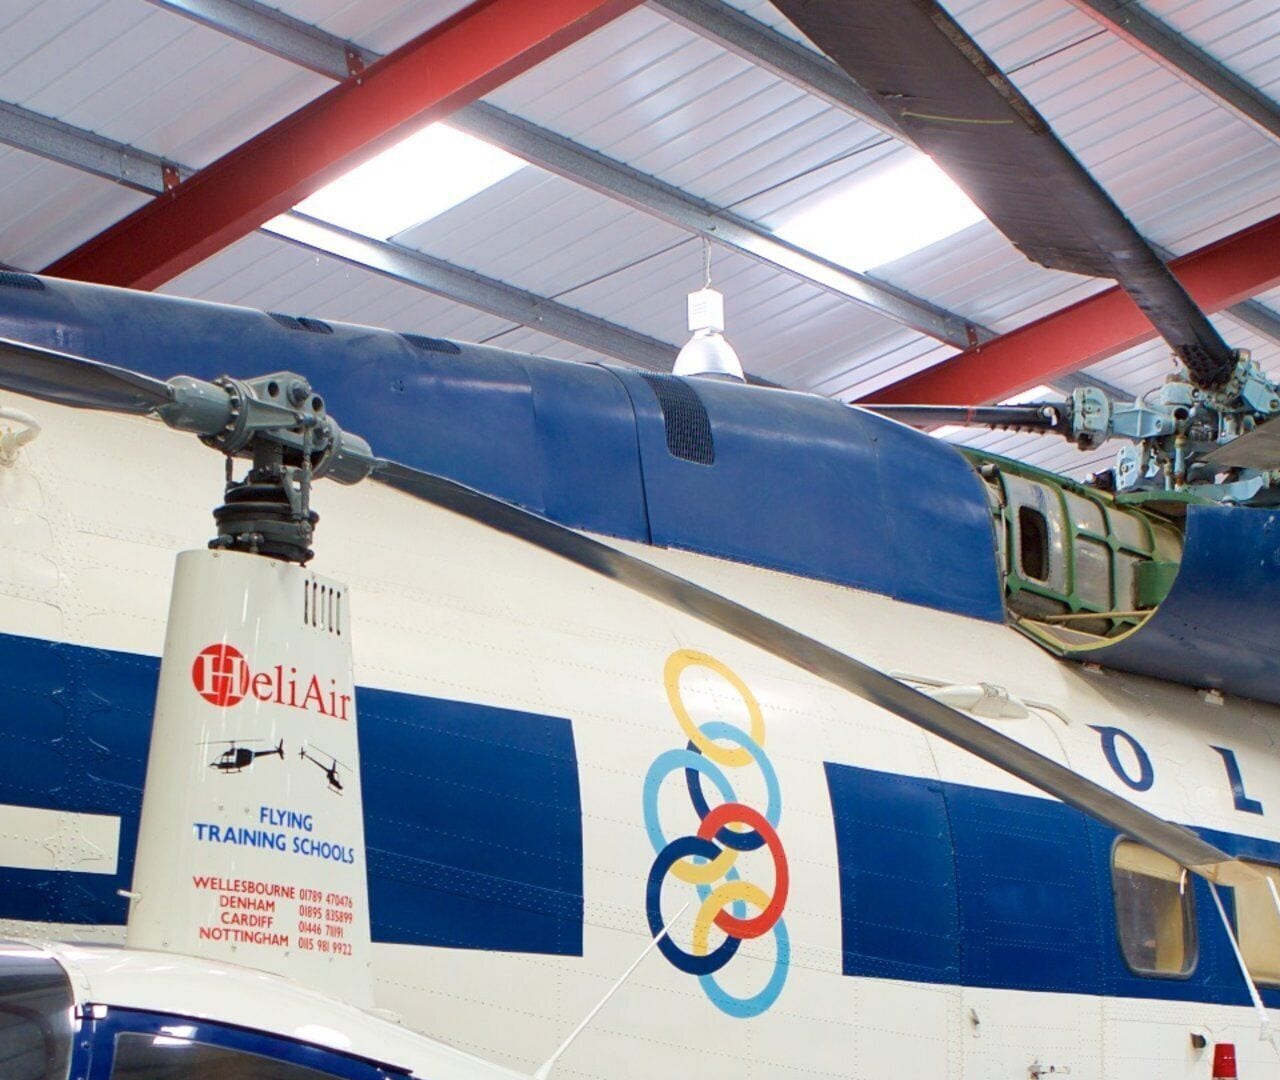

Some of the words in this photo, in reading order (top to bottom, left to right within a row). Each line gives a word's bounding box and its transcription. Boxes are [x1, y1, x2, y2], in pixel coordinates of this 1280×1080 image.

[192, 643, 351, 721] HeliAir
[260, 806, 313, 831] FLYING
[193, 823, 287, 851] TRAINING
[292, 836, 354, 864] SCHOOLS
[192, 875, 295, 899] WELLESBOURNE
[299, 888, 322, 903] 01789
[219, 895, 275, 912] DENHAM
[299, 905, 322, 919] 01895
[220, 911, 274, 928] CARDIFF
[199, 927, 289, 947] NOTTINGHAM
